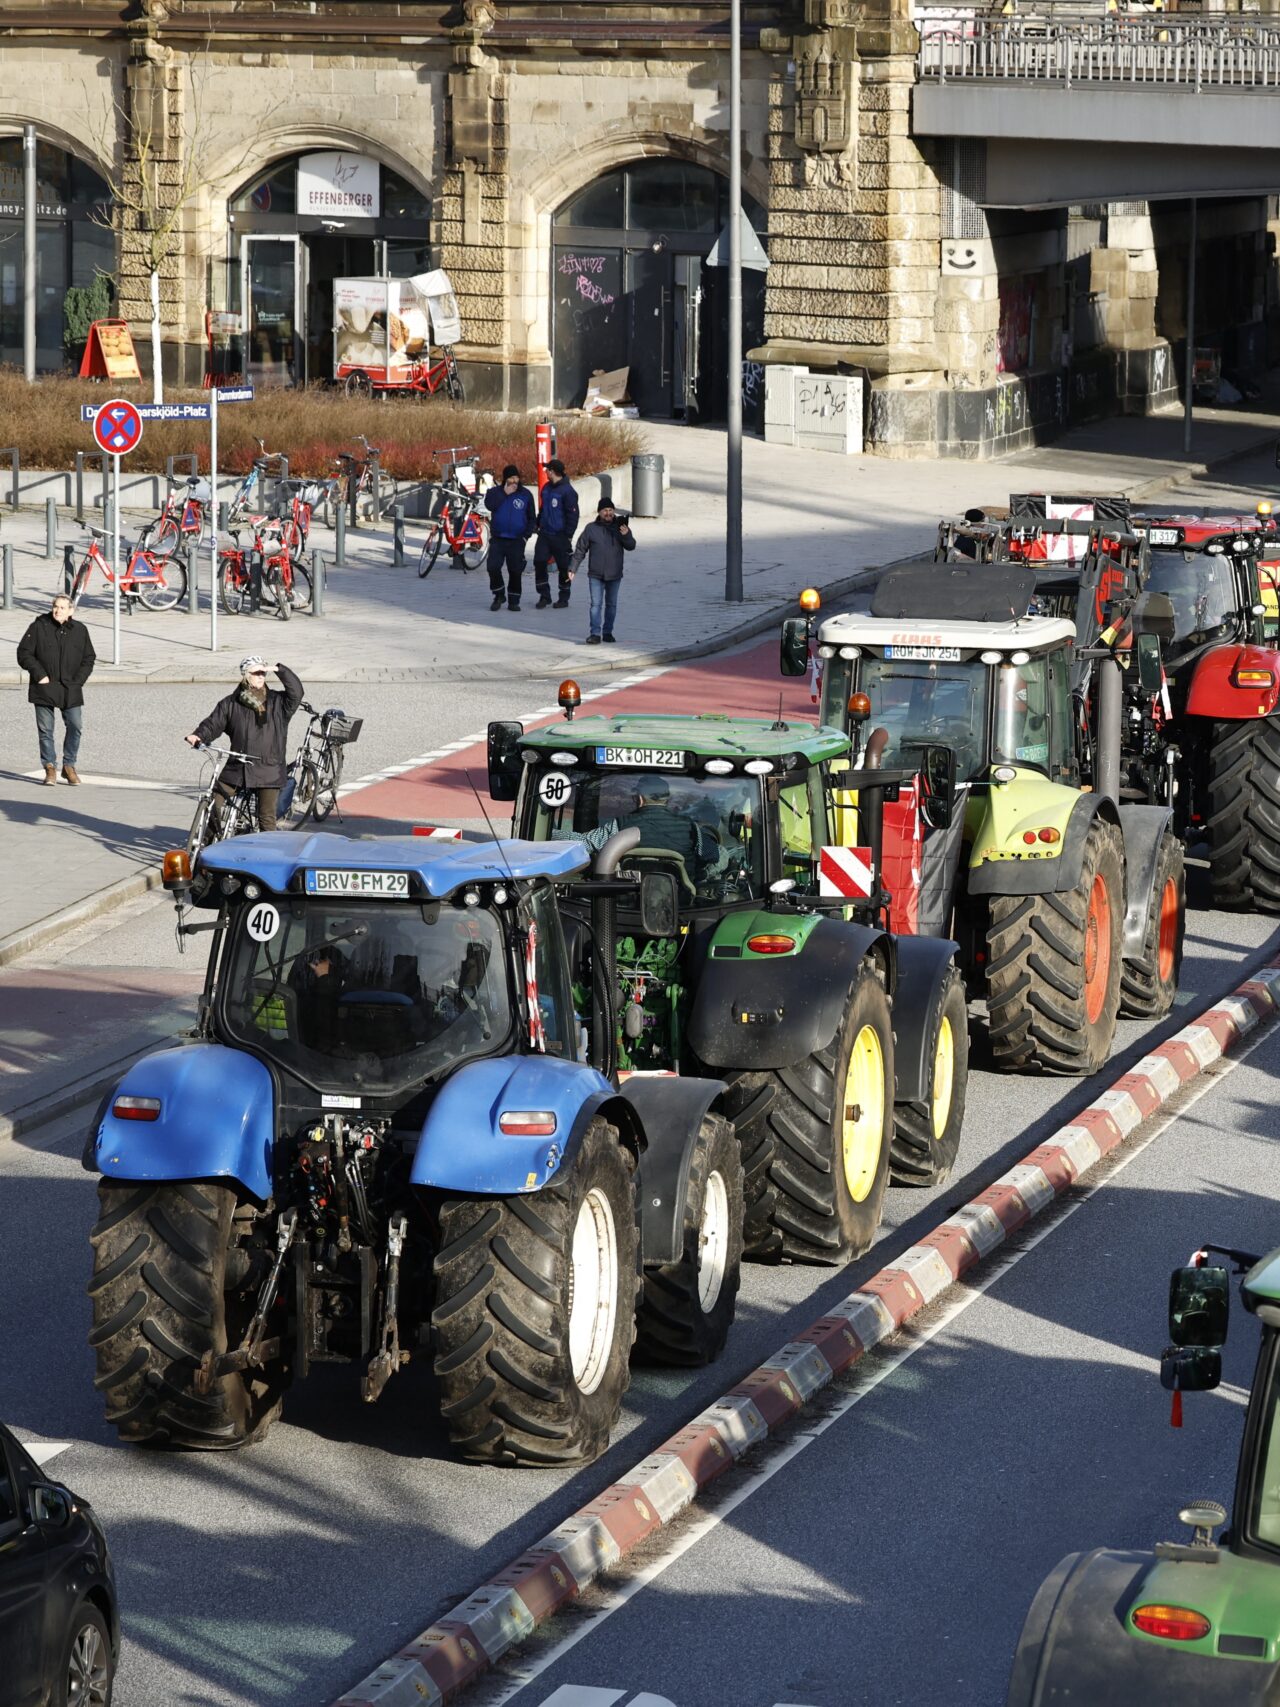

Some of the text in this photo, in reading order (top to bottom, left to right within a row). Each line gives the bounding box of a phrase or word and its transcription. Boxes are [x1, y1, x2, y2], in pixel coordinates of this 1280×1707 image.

[309, 191, 373, 206] EFFENBERGER
[1160, 531, 1177, 540] 317
[892, 634, 942, 645] CLAAS
[893, 646, 959, 659] ROW JR 254
[606, 748, 683, 766] BK OH 221
[545, 778, 564, 800] 50
[317, 873, 408, 891] BRV FM 29
[251, 909, 274, 935] 40
